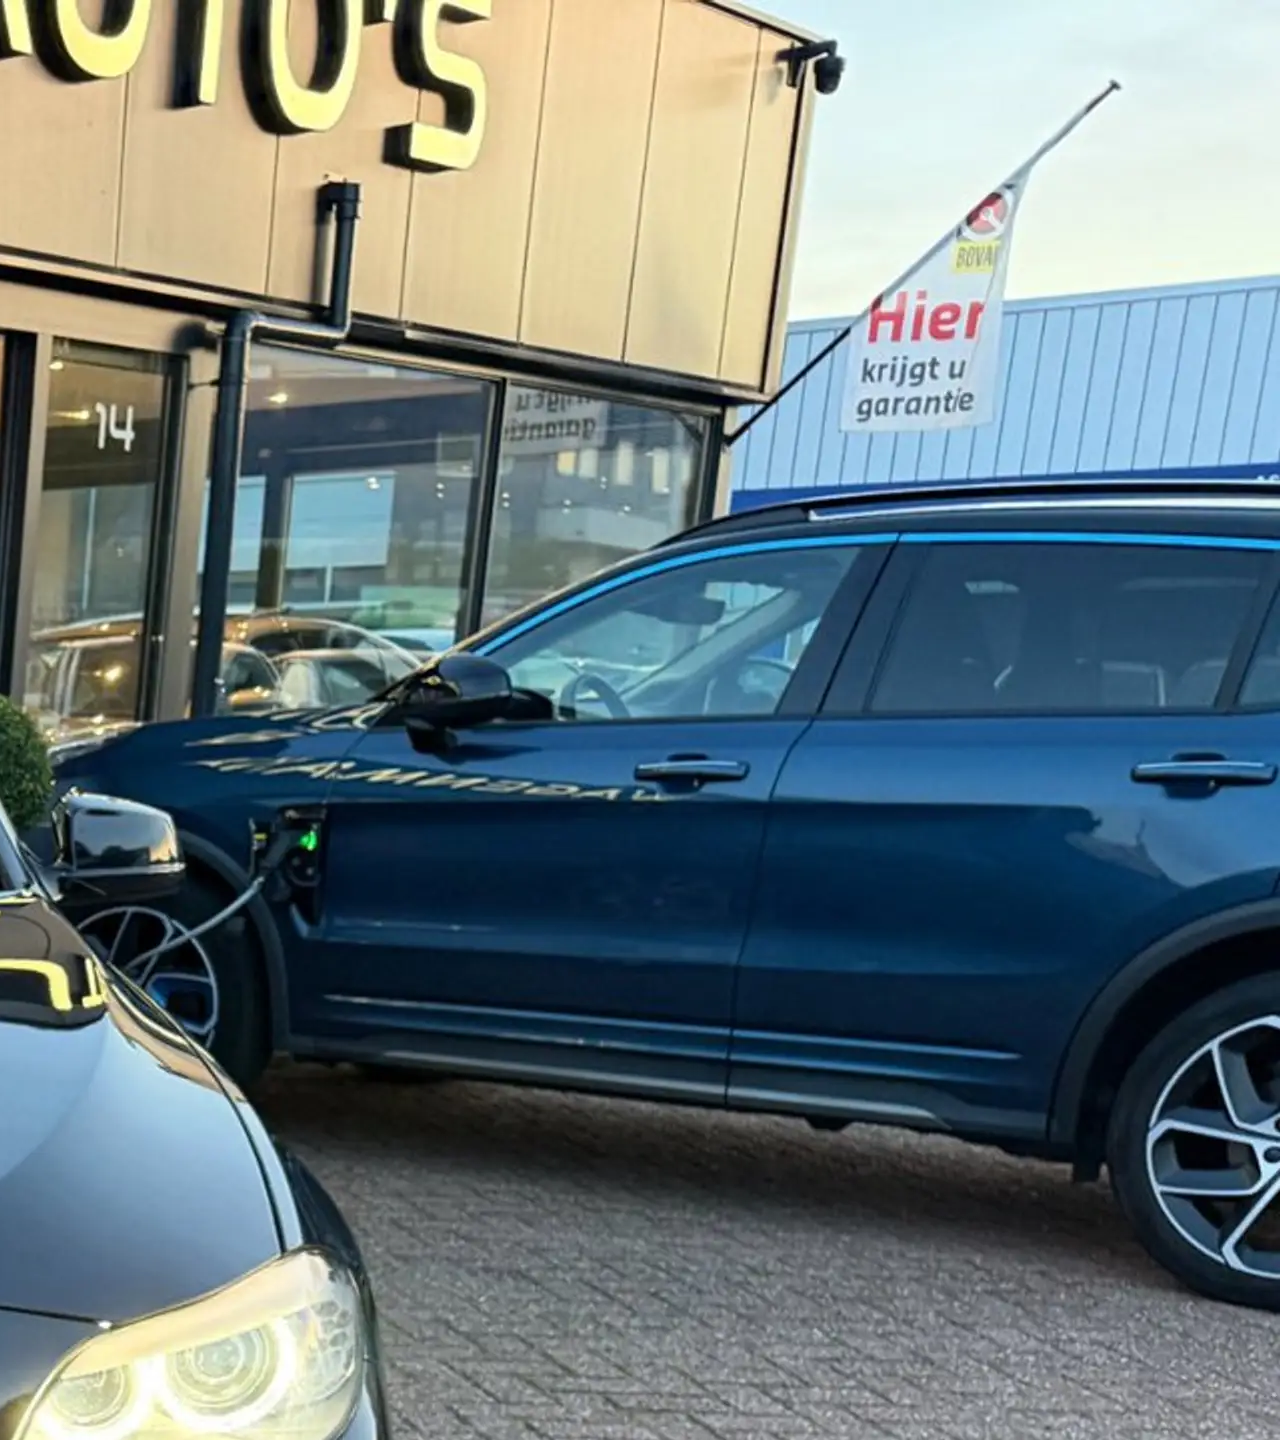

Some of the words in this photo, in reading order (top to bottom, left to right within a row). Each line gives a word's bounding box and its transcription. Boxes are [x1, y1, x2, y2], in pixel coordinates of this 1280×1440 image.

[955, 245, 1000, 269] BOVA
[868, 290, 984, 343] Hier
[861, 357, 941, 387] krijgt
[948, 360, 967, 379] u
[856, 388, 975, 423] garantie
[95, 402, 136, 453] 14
